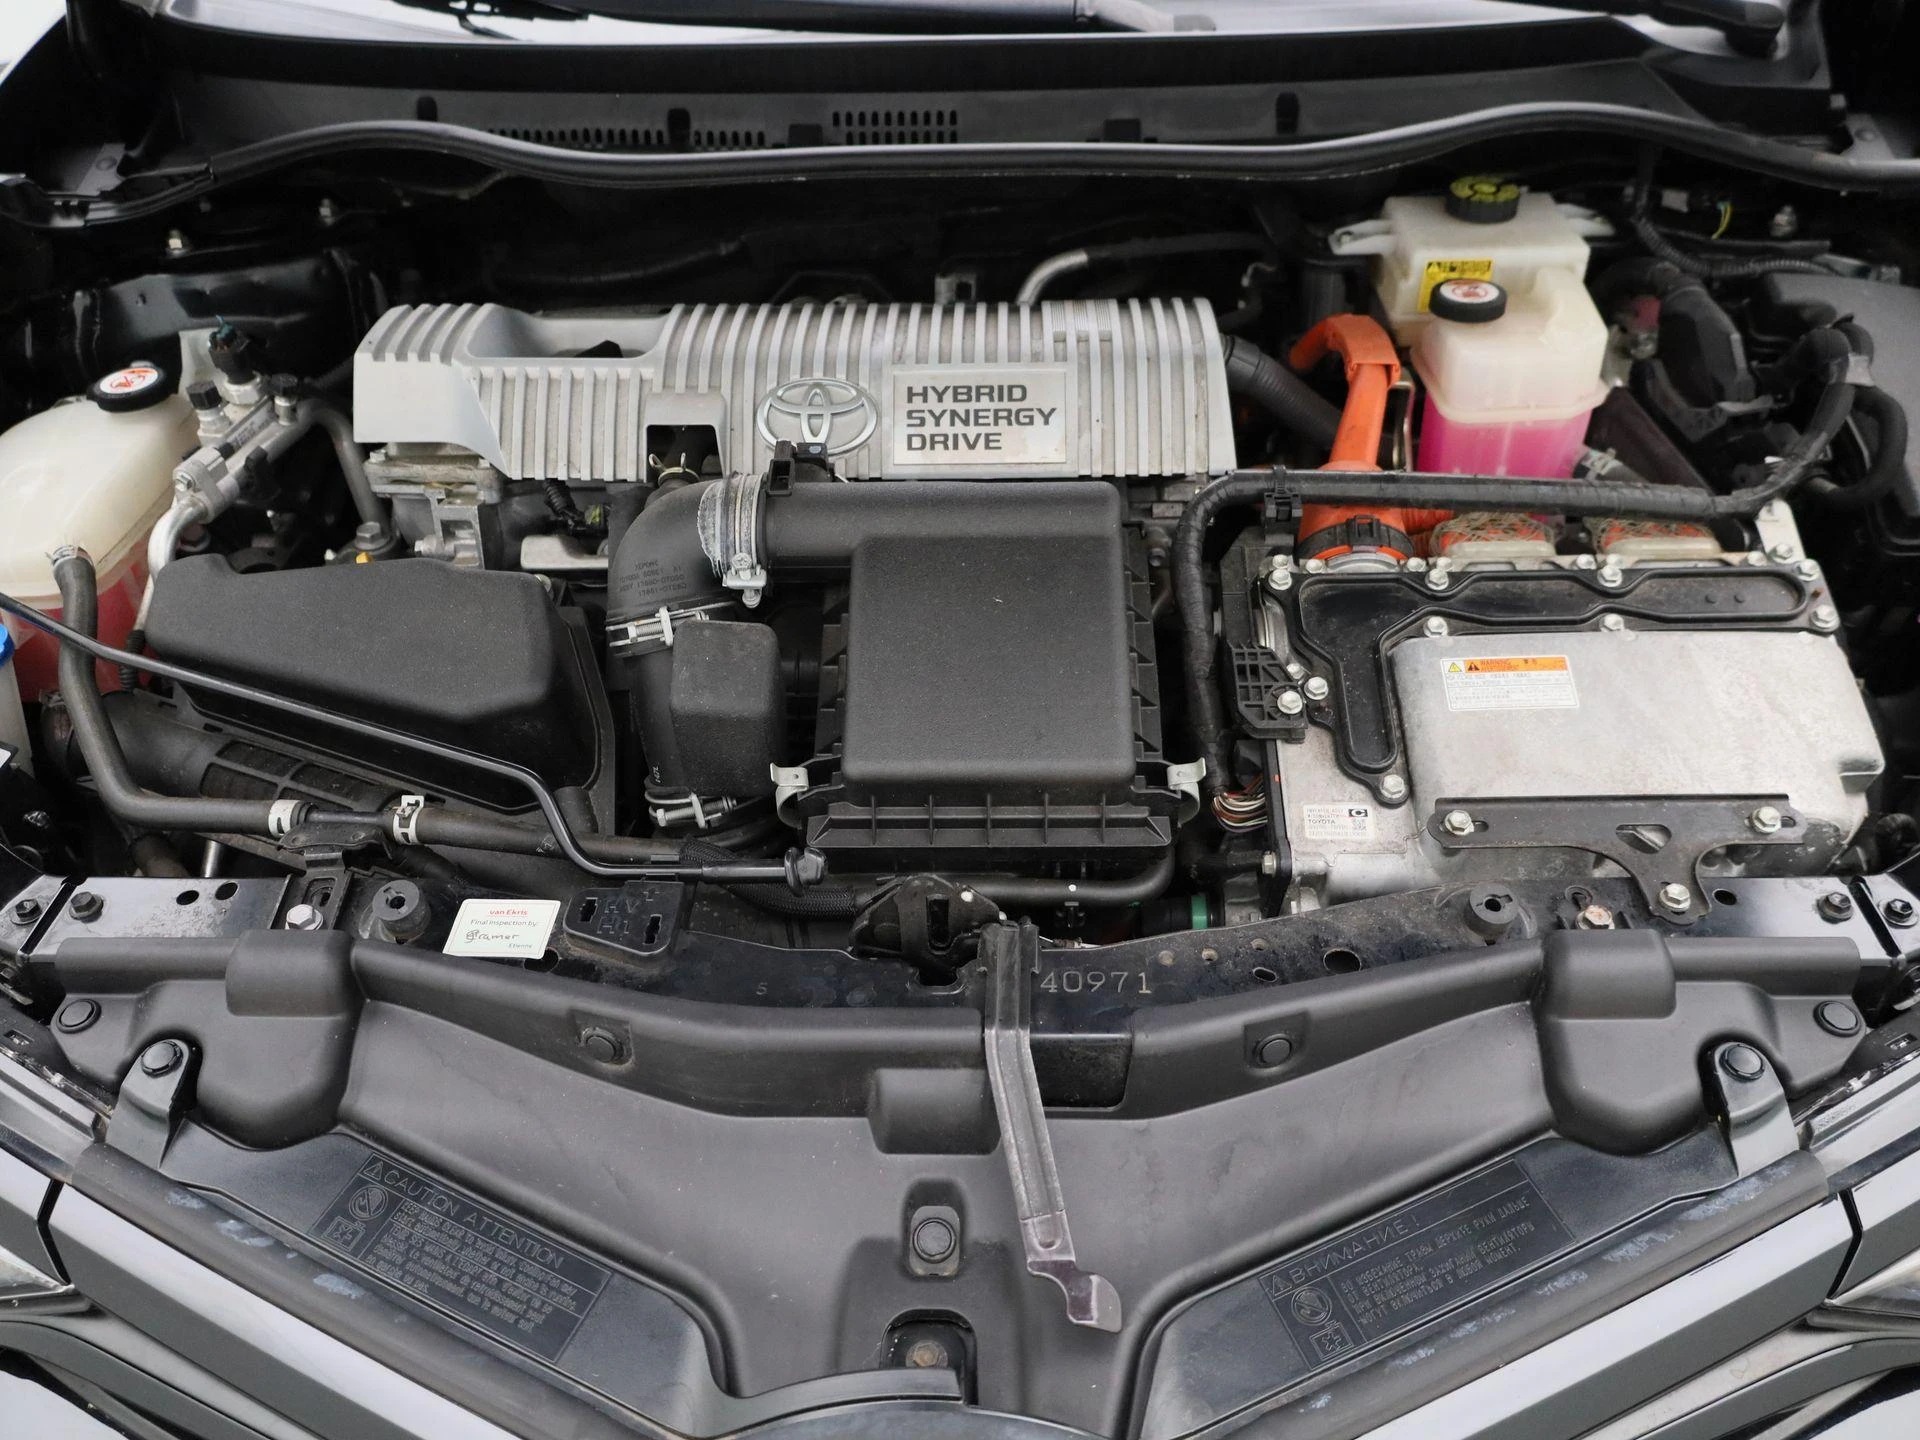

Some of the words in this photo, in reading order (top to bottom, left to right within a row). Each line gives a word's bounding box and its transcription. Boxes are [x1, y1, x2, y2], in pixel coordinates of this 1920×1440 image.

[906, 384, 1027, 404] HYBRID
[906, 407, 1057, 427] SYNERGY
[906, 432, 1002, 452] DRIVE
[1040, 971, 1152, 994] 40971
[400, 1200, 421, 1215] KEEP
[384, 1170, 460, 1216] CAUTION
[466, 1212, 564, 1269] ATTENTION
[1287, 1218, 1409, 1284] ВНИМАНИЕ
